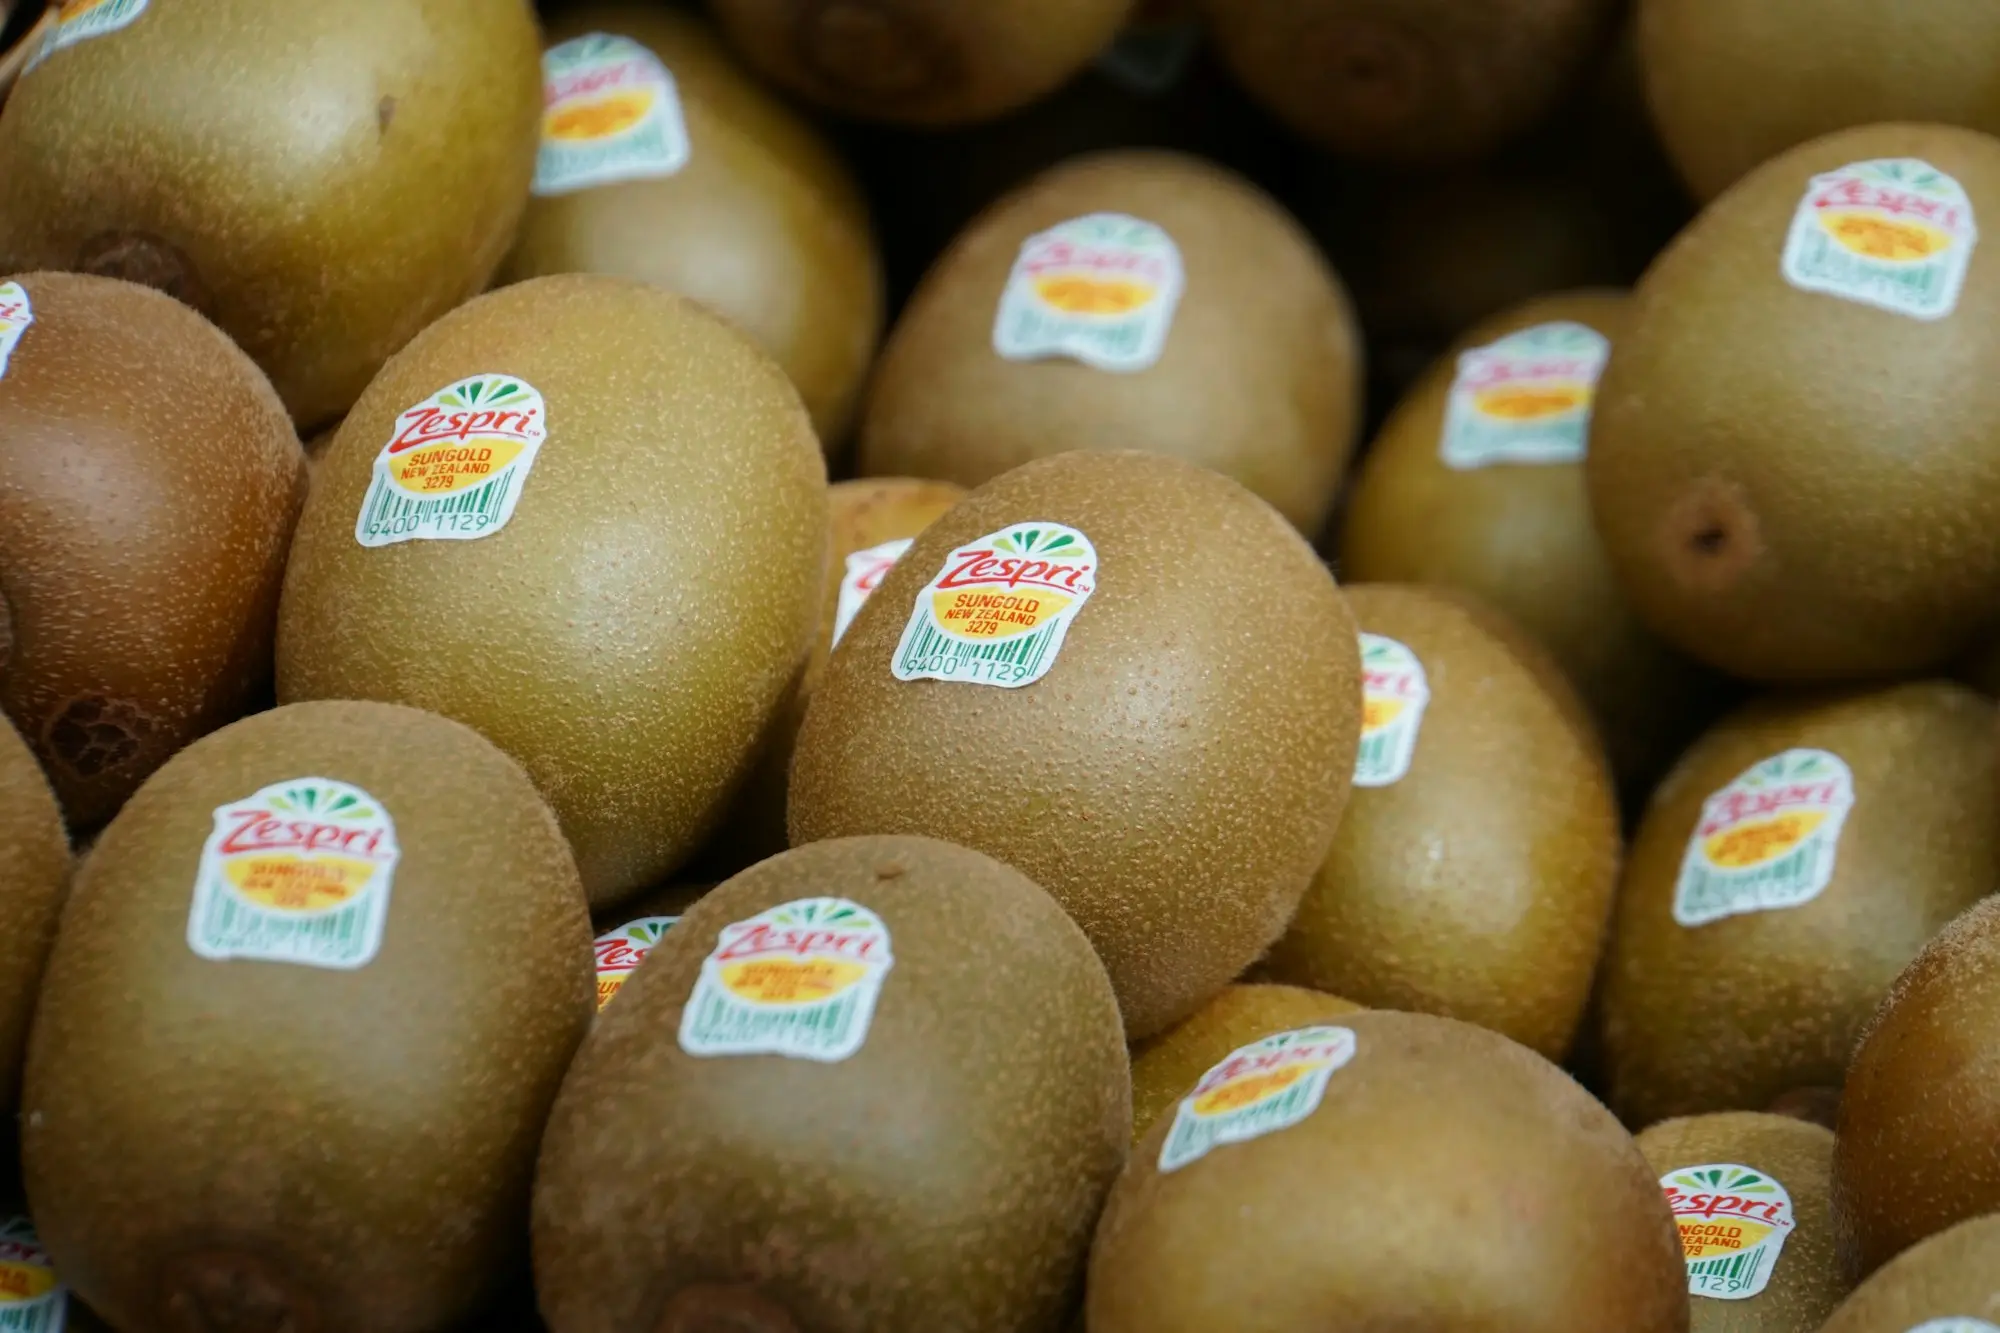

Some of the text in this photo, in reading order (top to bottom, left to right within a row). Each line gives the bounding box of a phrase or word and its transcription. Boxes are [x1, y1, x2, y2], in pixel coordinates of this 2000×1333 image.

[388, 407, 537, 454] Zespri
[408, 448, 492, 466] SUNGOLD
[400, 462, 491, 480] NEW ZEALAND
[423, 475, 455, 489] 3279
[369, 513, 489, 540] 9400 1129
[936, 550, 1091, 595] Zespri
[954, 593, 1040, 614] SUNGOLD
[944, 609, 1037, 627] NEW ZEALAND
[965, 620, 998, 635] 3279
[905, 655, 1027, 683] 9400 1129
[219, 810, 386, 855] Zespri
[1664, 1187, 1784, 1226] espri
[1680, 1224, 1742, 1238] NGOLD
